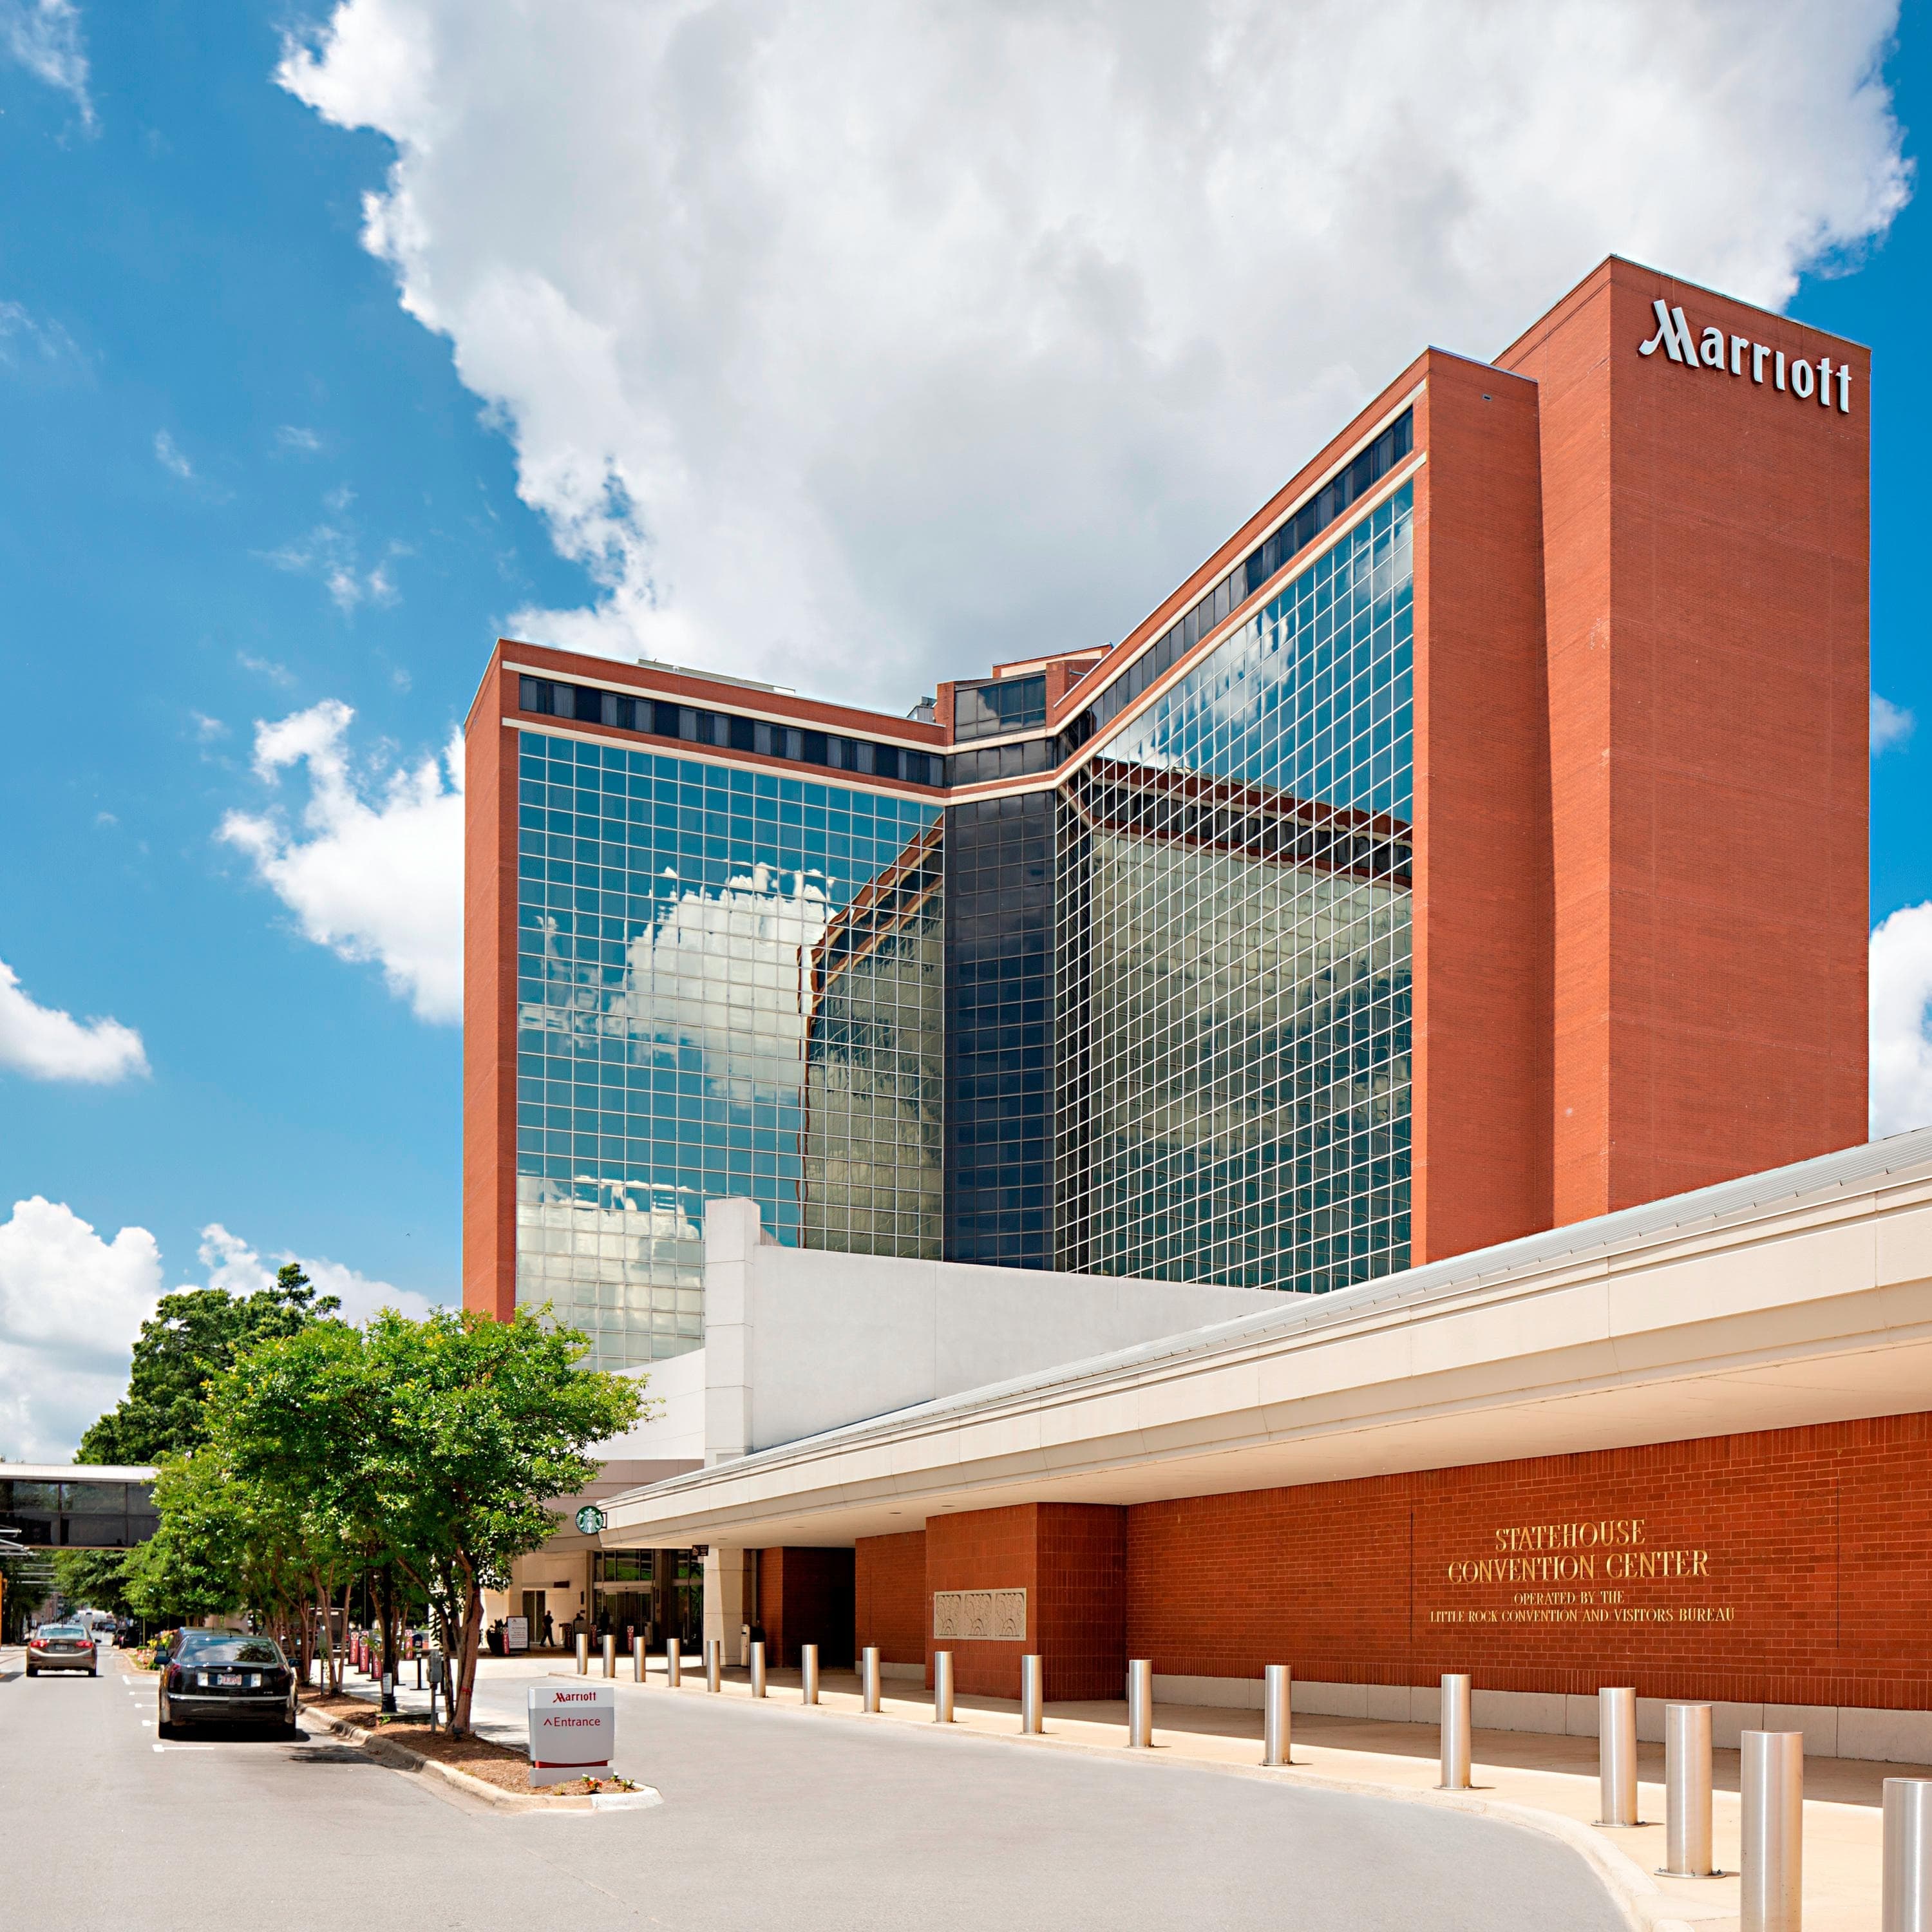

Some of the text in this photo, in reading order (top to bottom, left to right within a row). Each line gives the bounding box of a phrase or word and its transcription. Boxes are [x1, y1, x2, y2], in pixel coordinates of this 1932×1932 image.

[1638, 299, 1852, 413] Marriott
[1495, 1519, 1645, 1552] STATEHOUSE
[1448, 1549, 1709, 1584] CONVENTION CENTER
[1514, 1590, 1624, 1605] OPERATED BY THE
[1430, 1607, 1735, 1622] LITTLE ROCK CONVENTION AND VISITORS BUREAU
[553, 1692, 596, 1703] Marriott
[554, 1717, 600, 1727] Entrance
